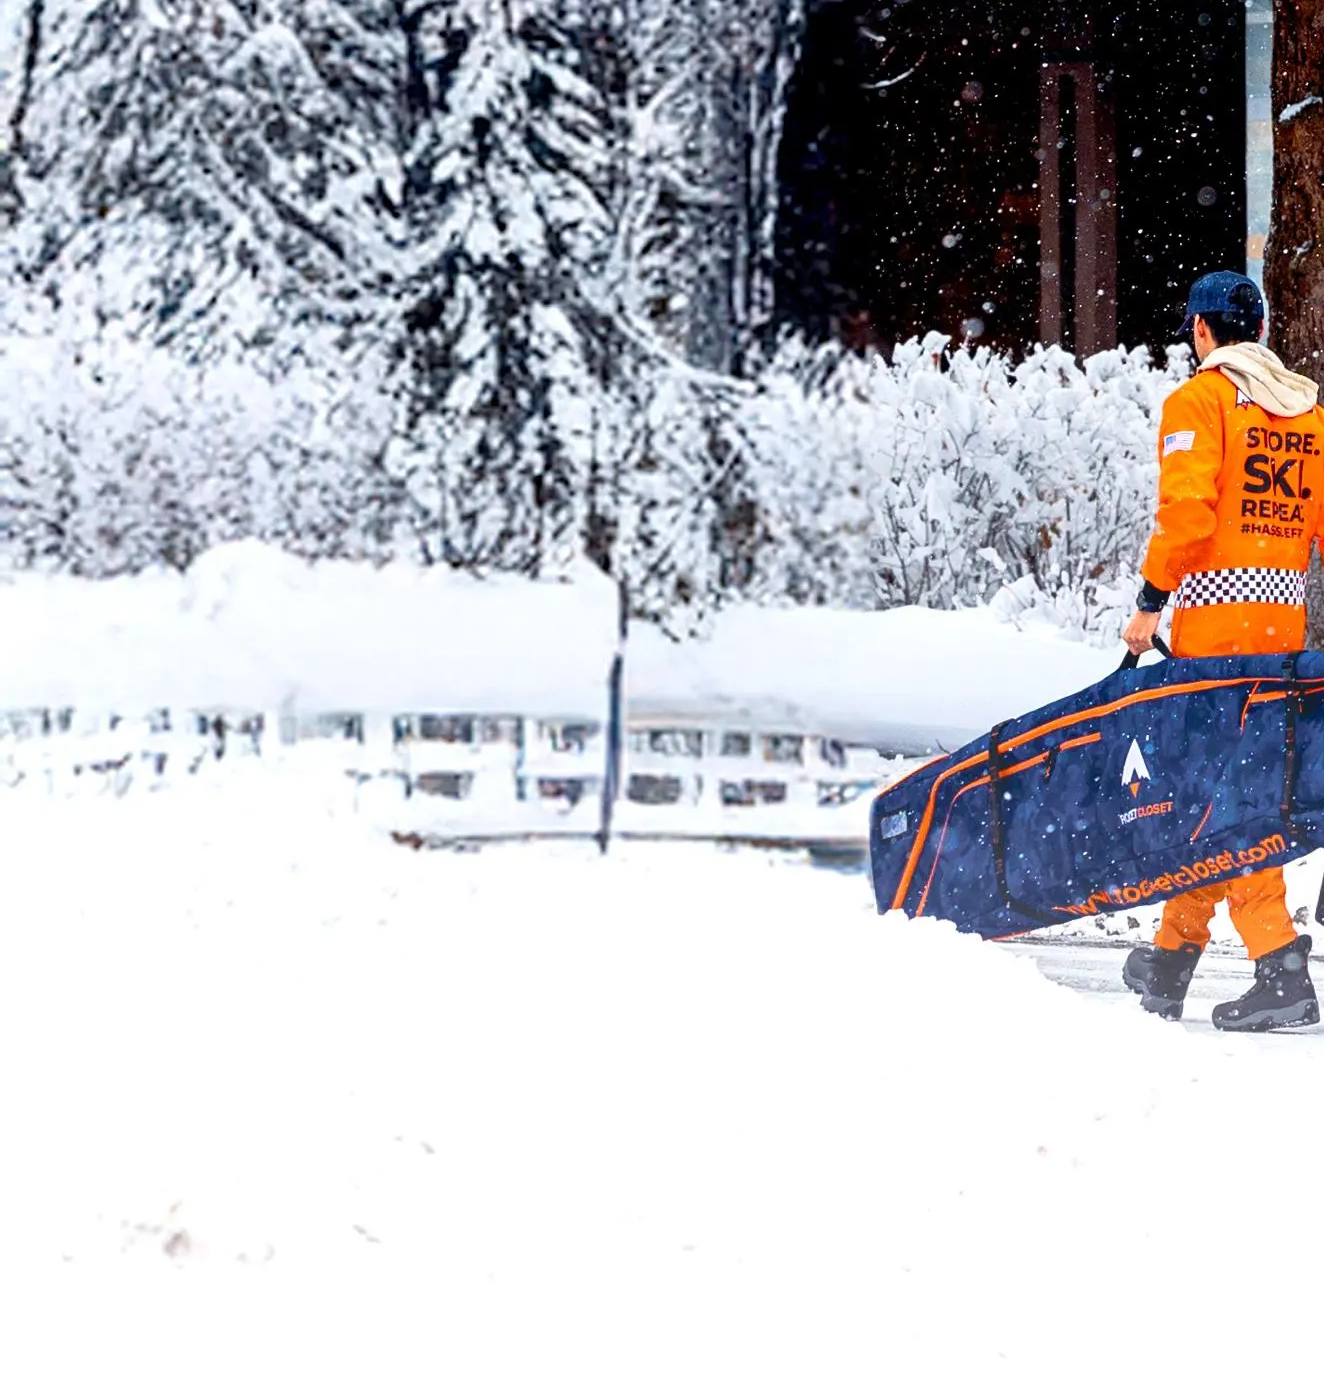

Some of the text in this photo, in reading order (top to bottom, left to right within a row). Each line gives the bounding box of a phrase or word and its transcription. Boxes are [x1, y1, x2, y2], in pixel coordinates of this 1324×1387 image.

[1246, 427, 1320, 456] STORE.
[1242, 454, 1312, 499] SKI.
[1241, 499, 1305, 523] REPEA.
